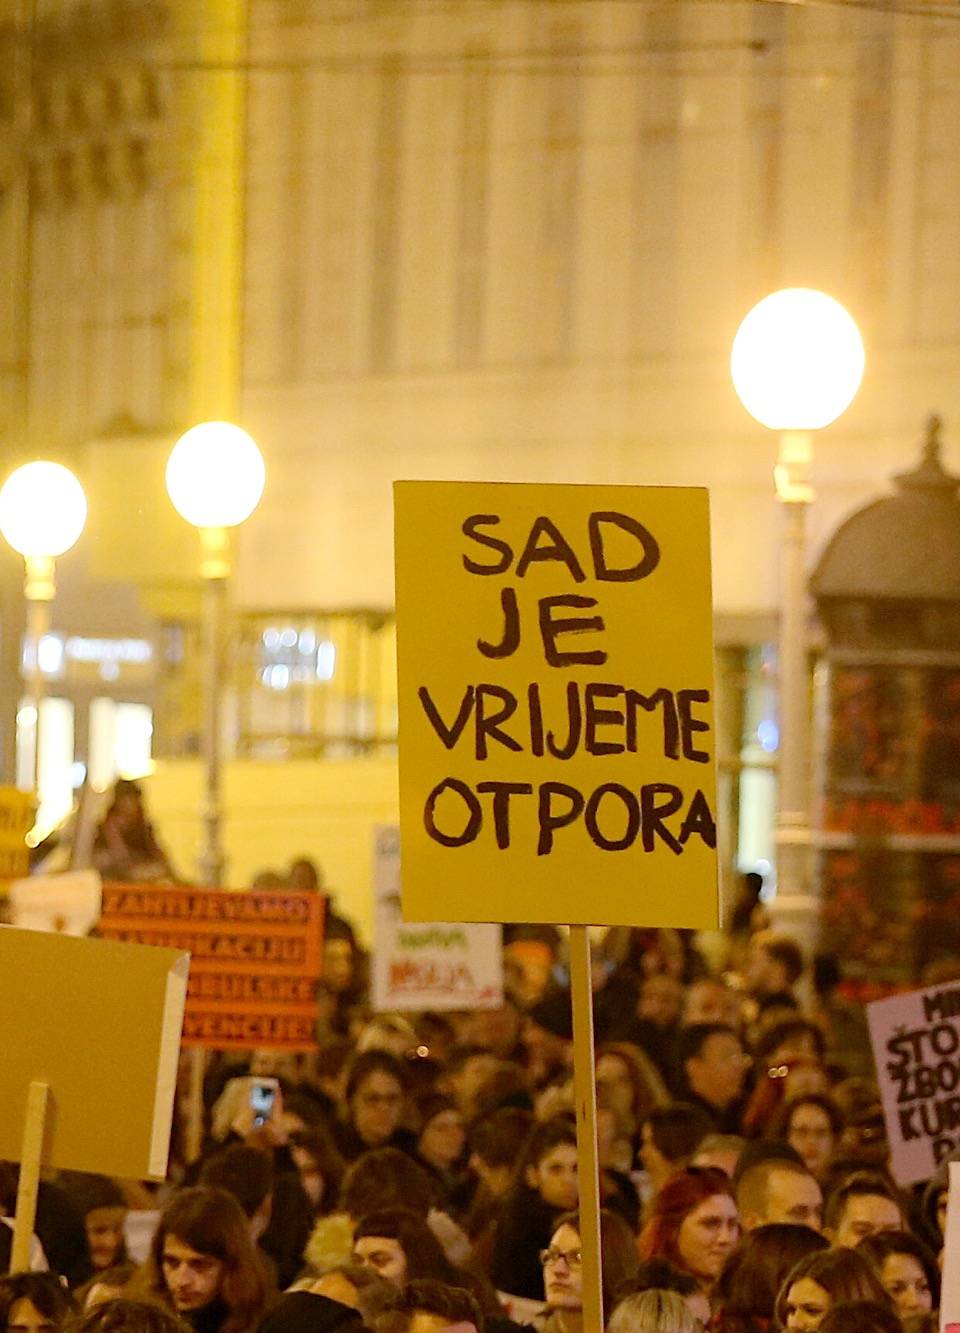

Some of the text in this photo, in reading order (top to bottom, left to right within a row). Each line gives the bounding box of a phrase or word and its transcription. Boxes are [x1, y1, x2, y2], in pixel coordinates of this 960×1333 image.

[462, 511, 660, 583] SAD
[477, 587, 608, 668] JE
[418, 681, 710, 764] VRIJEME
[423, 776, 718, 857] OTPORA
